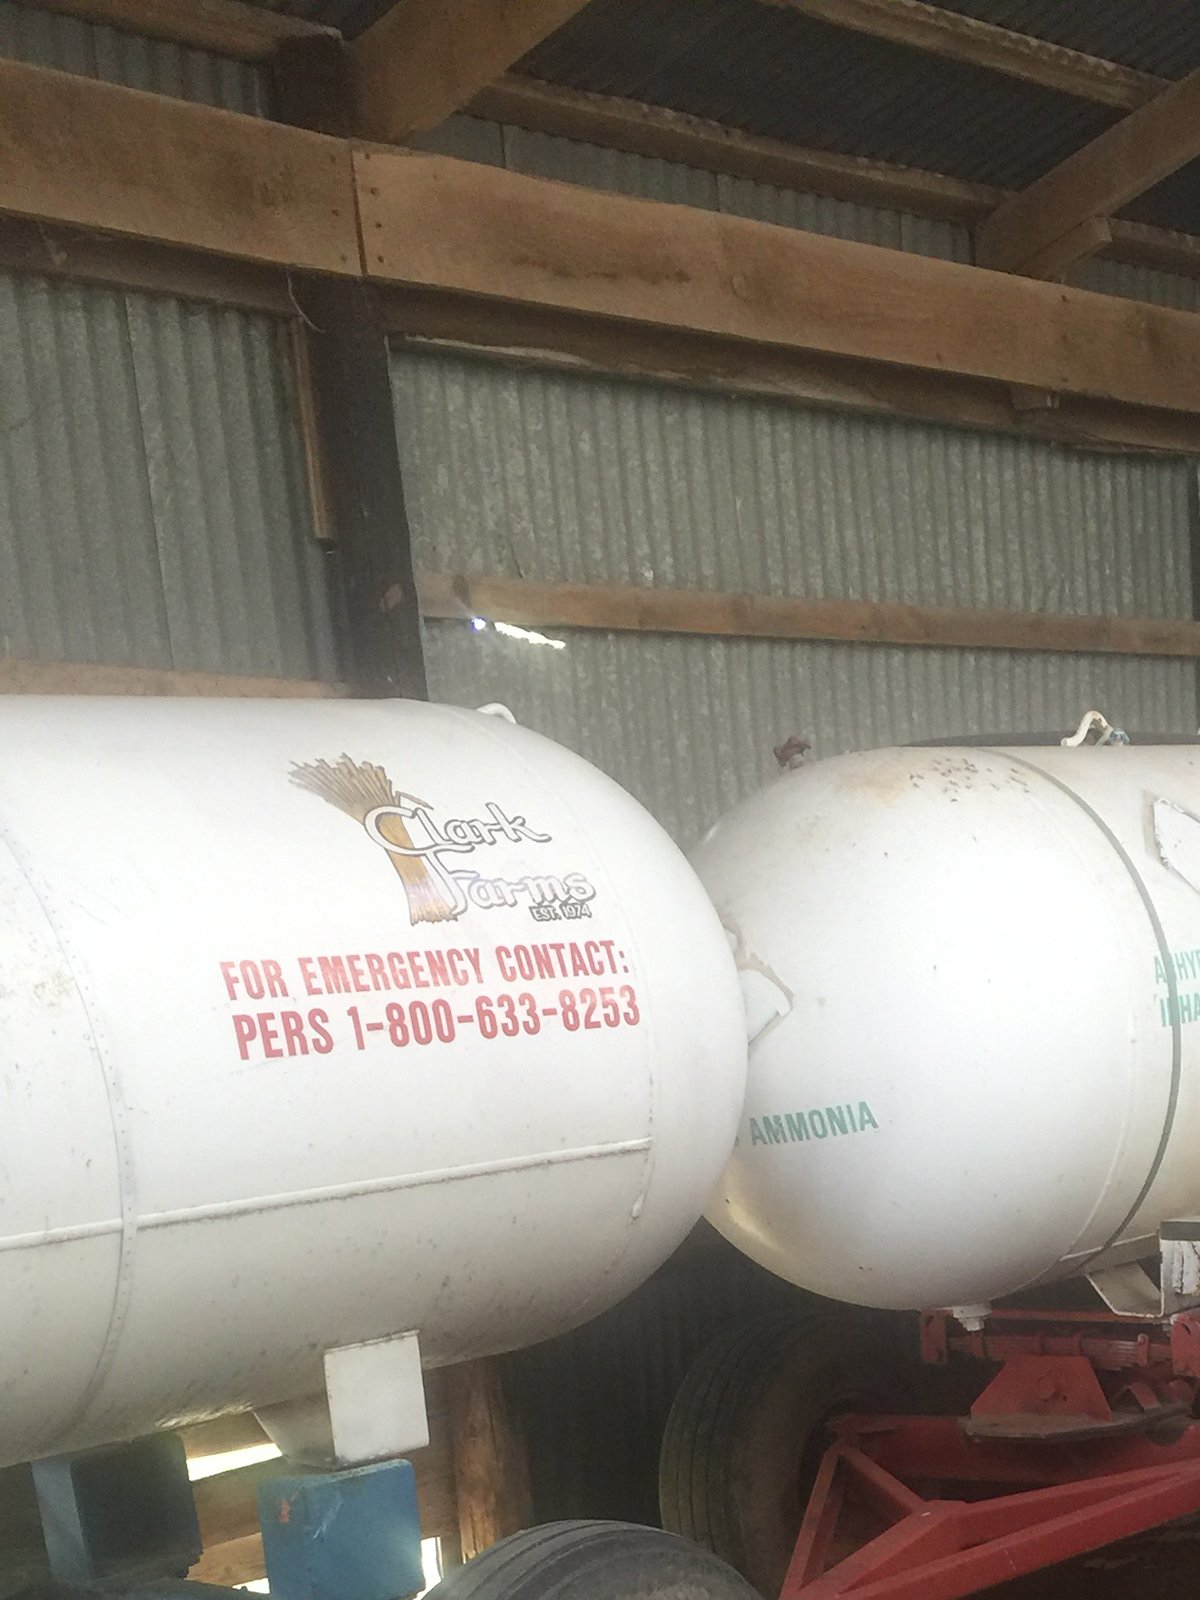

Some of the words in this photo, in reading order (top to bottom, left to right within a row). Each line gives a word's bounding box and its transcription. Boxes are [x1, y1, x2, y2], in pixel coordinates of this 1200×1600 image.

[365, 803, 552, 856] Clark
[424, 846, 597, 916] Farms
[529, 905, 561, 921] EST.
[562, 903, 592, 919] 1974
[219, 959, 289, 1001] FOR
[298, 947, 485, 997] EMERGENCY
[499, 939, 630, 982] CONTACT:
[232, 1007, 334, 1060] PERS
[346, 984, 641, 1050] 1-800-633-8253
[749, 1100, 879, 1146] AMMONIA
